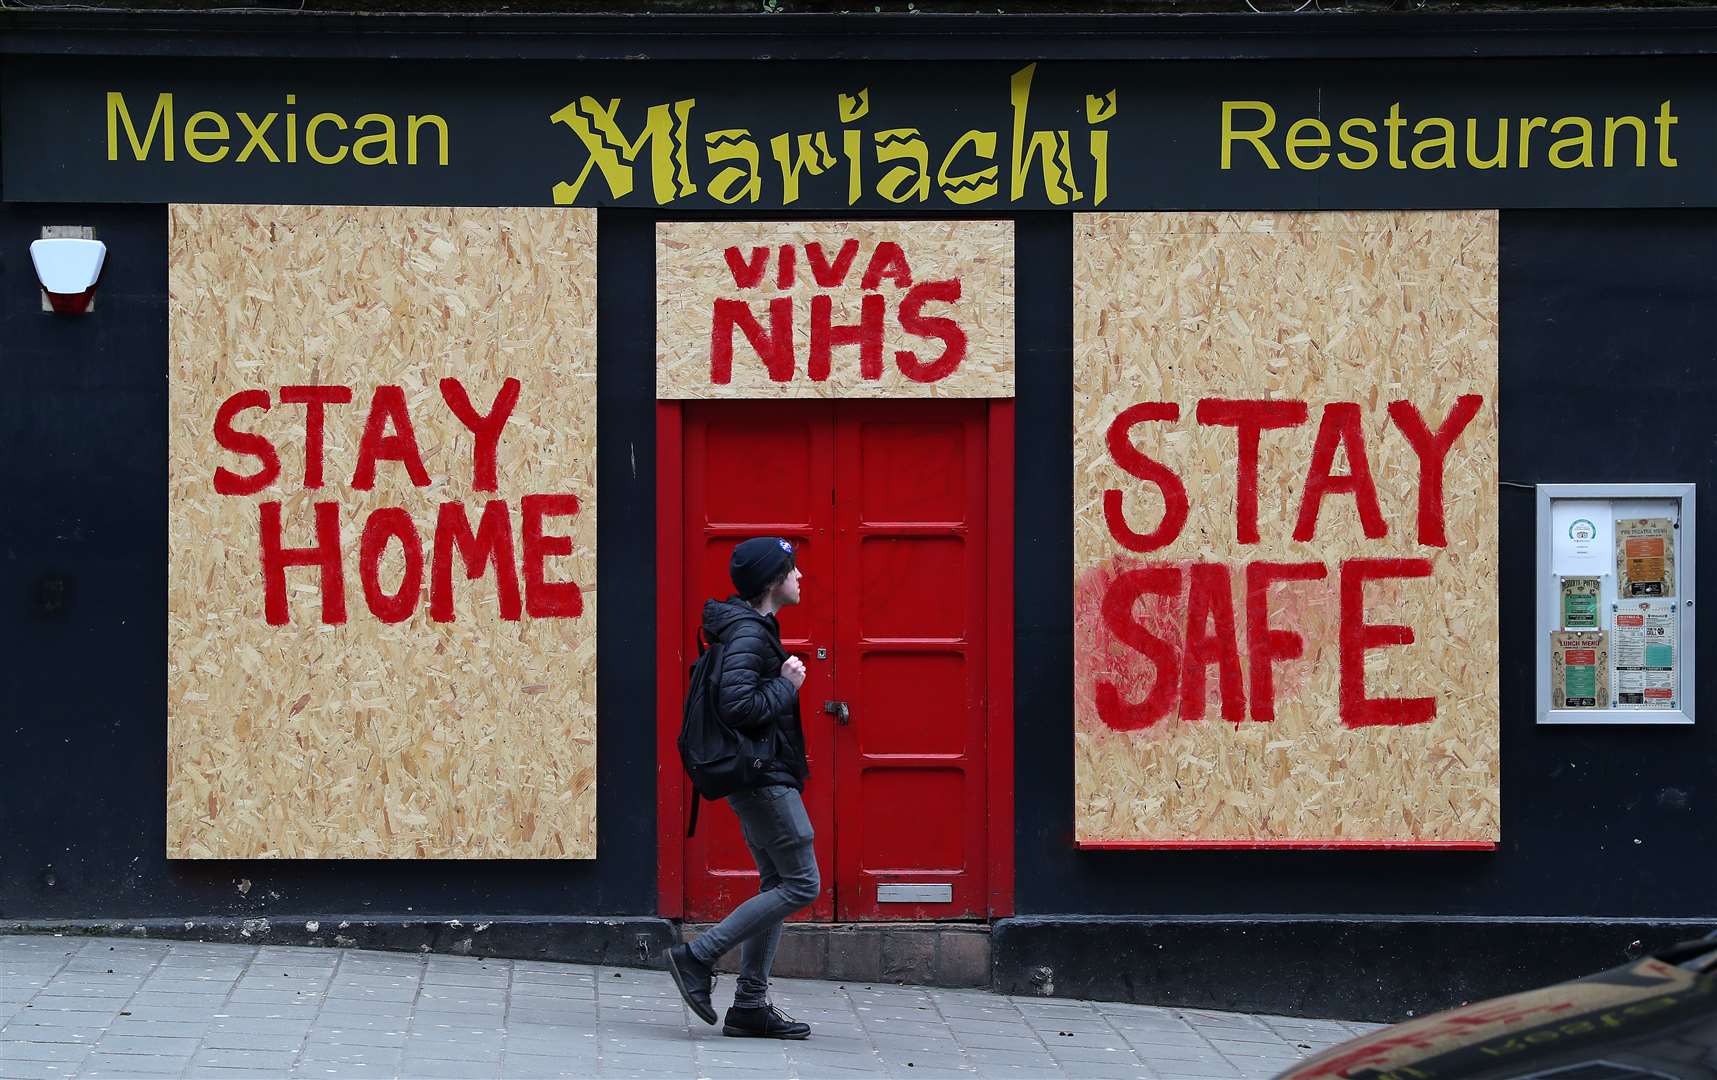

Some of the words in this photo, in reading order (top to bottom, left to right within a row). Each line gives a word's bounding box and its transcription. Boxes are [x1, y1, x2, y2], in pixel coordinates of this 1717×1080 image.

[106, 91, 450, 166] Mexican
[551, 62, 1117, 206] Mariachi
[1221, 100, 1679, 170] Restaurant
[725, 240, 912, 289] VIVA
[710, 279, 968, 385] NHS
[213, 377, 522, 496] STAY
[1104, 394, 1484, 554] STAY
[259, 494, 584, 627] HOME
[1096, 557, 1437, 731] SAFE
